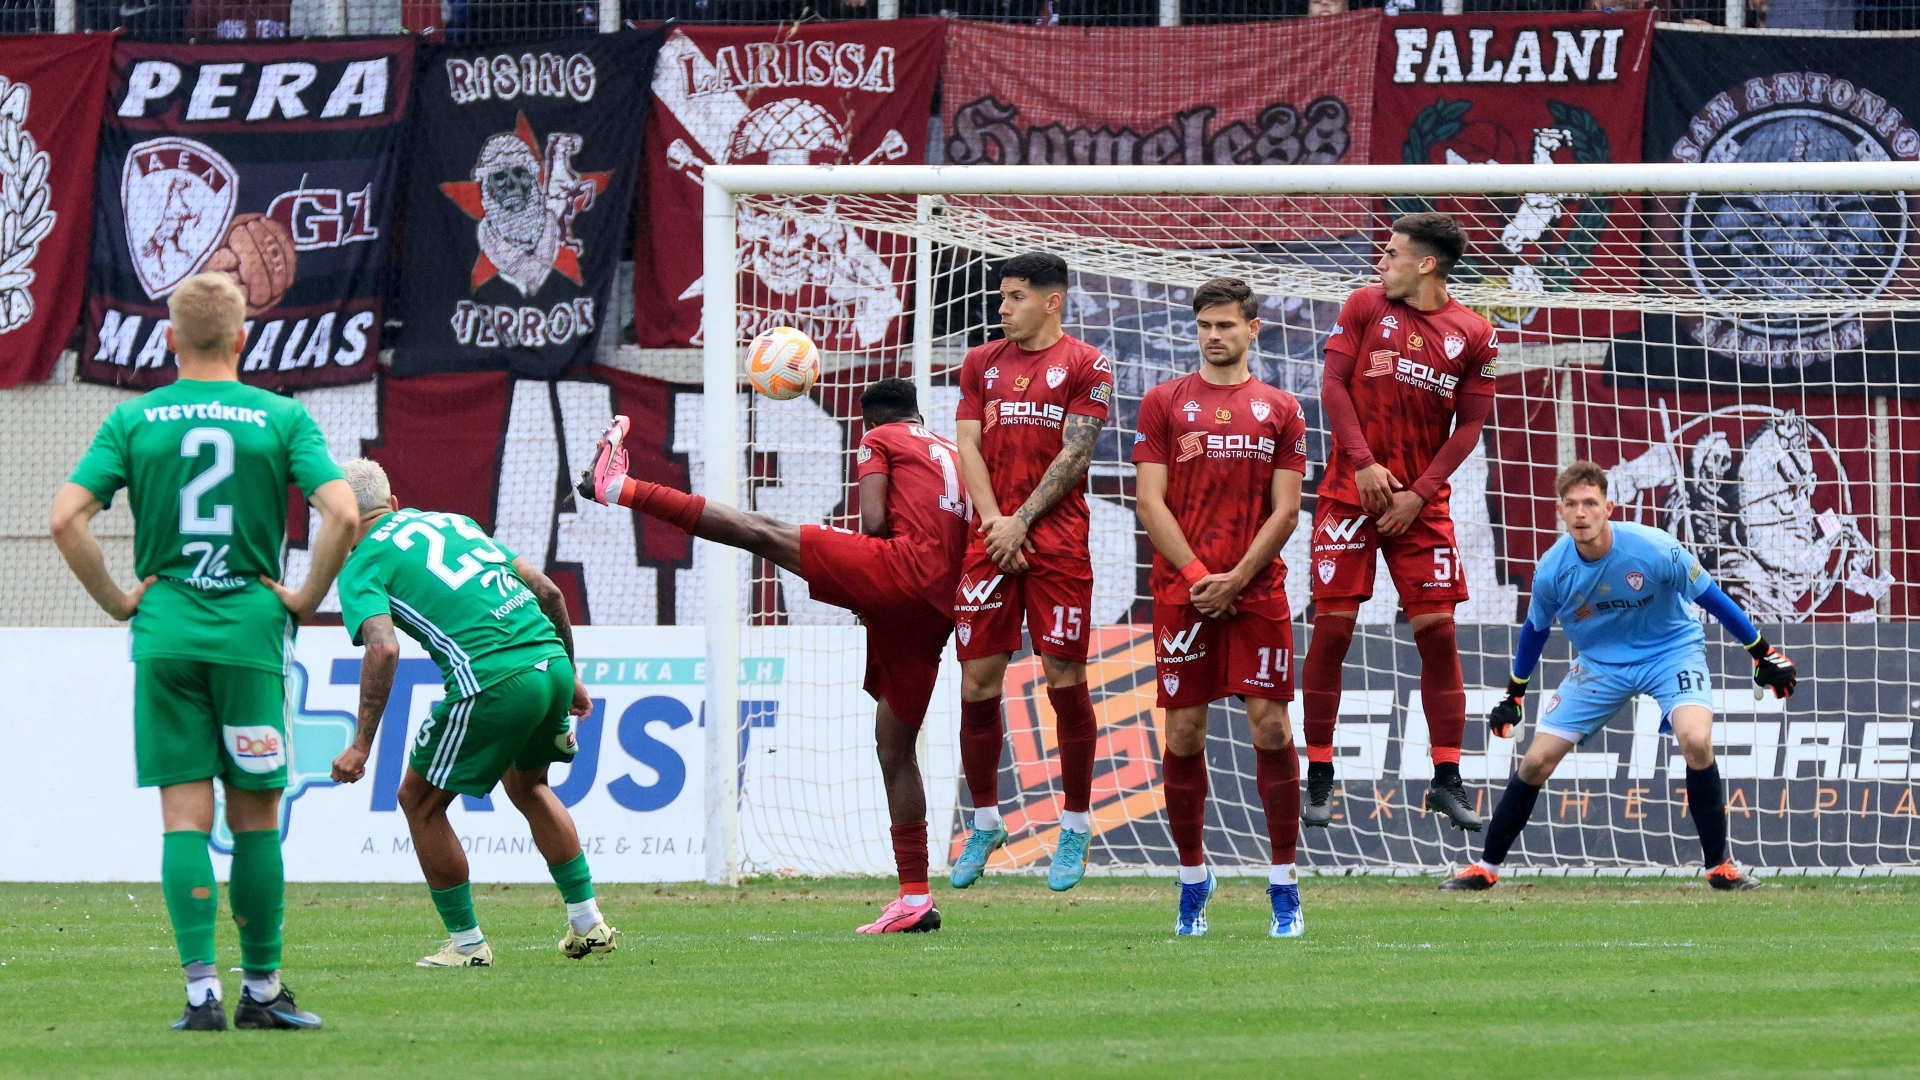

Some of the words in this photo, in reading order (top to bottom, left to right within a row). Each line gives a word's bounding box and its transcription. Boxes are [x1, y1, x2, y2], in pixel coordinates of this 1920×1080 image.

[678, 40, 895, 99] LARISSA
[1393, 28, 1624, 84] FALANI
[117, 57, 389, 121] PERA
[446, 52, 596, 103] RISING
[1672, 91, 1739, 163] SAN
[1745, 71, 1920, 157] ANTONIO
[267, 182, 379, 251] G1
[93, 308, 375, 372] MAALAS
[1395, 373, 1453, 399] CONSTRUCTIONS
[1397, 357, 1459, 390] SOLIS
[143, 400, 268, 428] ντεντάκης
[1000, 401, 1064, 421] SOLIS
[1000, 416, 1060, 429] CONSTRUCTIONS
[1206, 434, 1275, 454] SOLIS
[1206, 450, 1272, 463] CONSTRUCTIONS
[179, 428, 234, 535] 2
[392, 512, 507, 591] 23
[168, 576, 247, 591] mpotis
[980, 601, 1003, 611] GROUP
[1050, 605, 1082, 641] 15
[576, 661, 673, 681] ΤΡΙΚΑ
[1163, 656, 1183, 664] WOOD
[1256, 647, 1289, 682] 14
[1677, 670, 1705, 691] 67
[236, 733, 278, 756] Dole
[615, 837, 631, 854] &
[641, 837, 676, 854] ΣΙΑ
